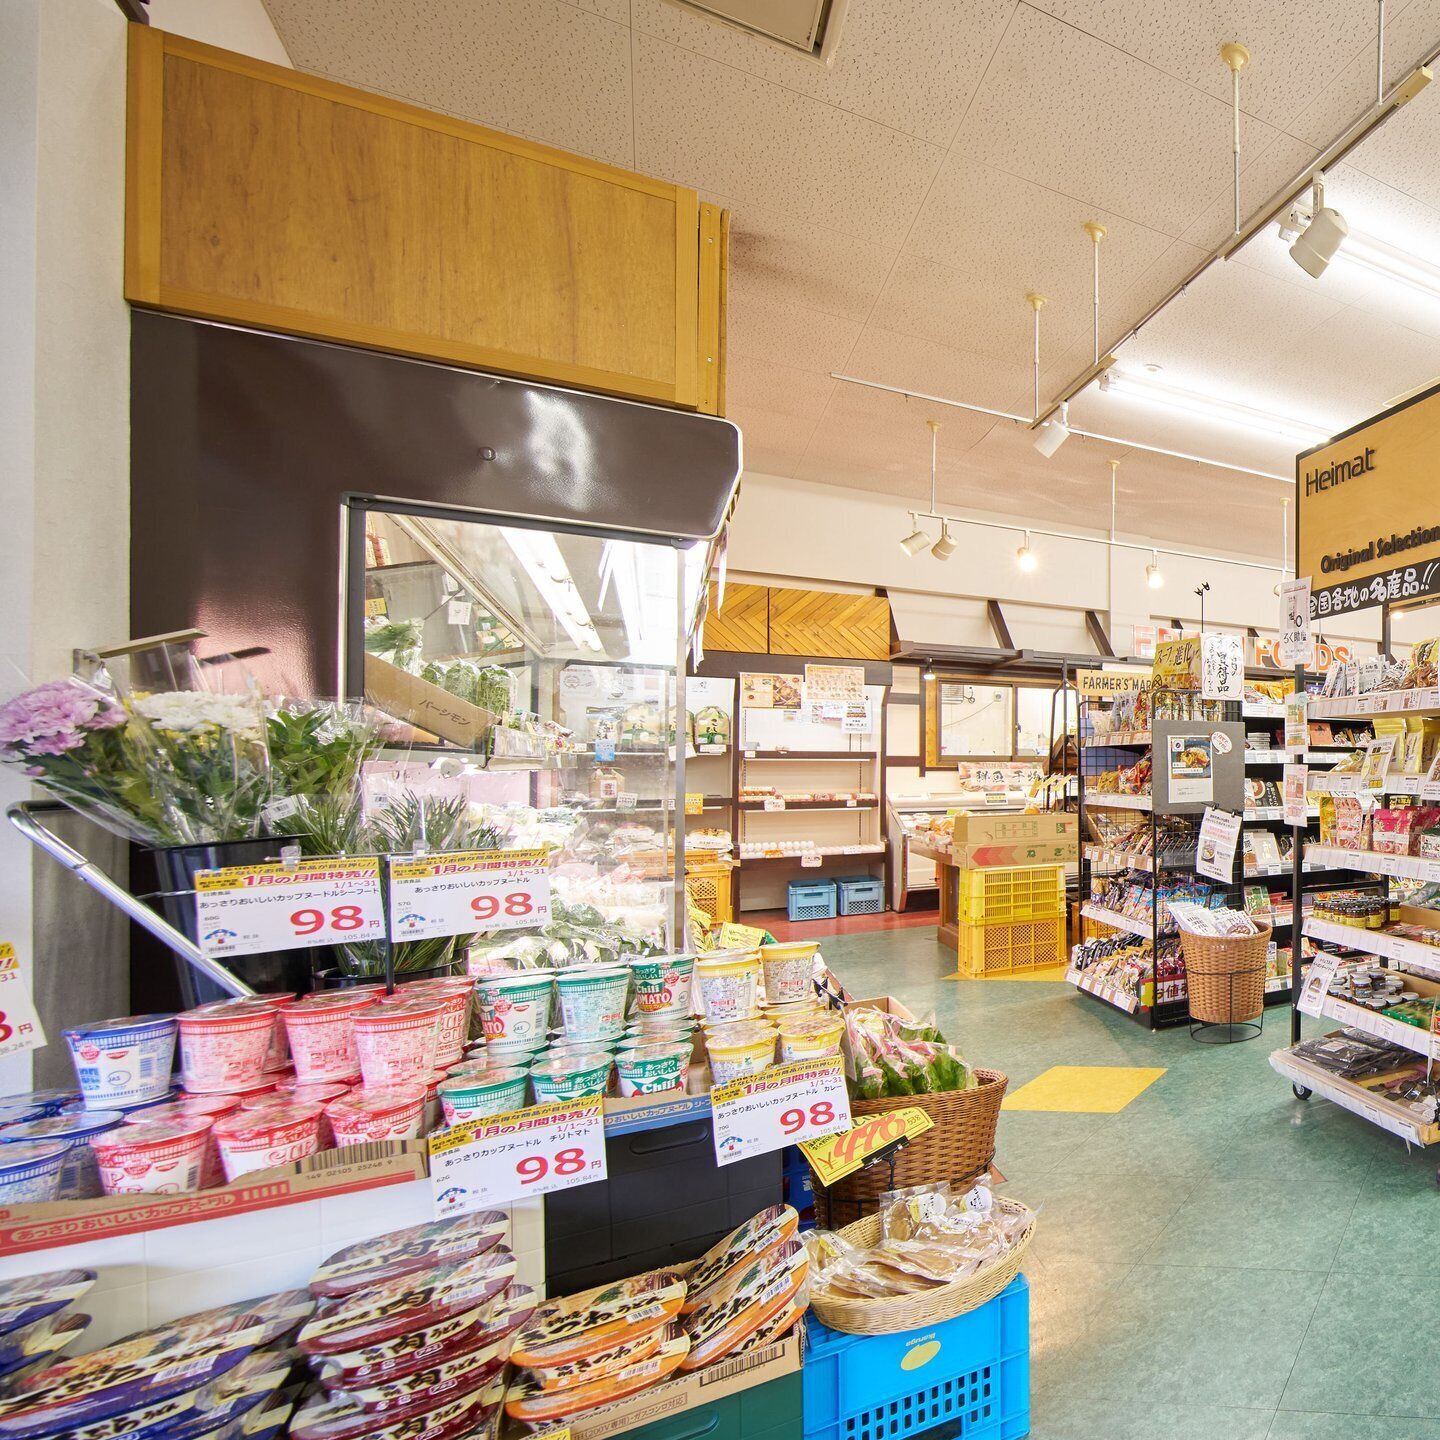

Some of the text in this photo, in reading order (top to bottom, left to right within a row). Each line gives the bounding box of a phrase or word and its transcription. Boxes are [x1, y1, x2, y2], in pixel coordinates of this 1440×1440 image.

[1305, 447, 1377, 497] Heimat
[1320, 538, 1374, 575] Original
[1255, 637, 1352, 675] FDS
[1082, 676, 1152, 692] FARMER'S MAR
[242, 869, 377, 887] 1月の月間特売!!
[430, 858, 545, 876] 1月の月間特売!!
[200, 888, 380, 910] あっさりおいしいカップヌードルシーフード
[414, 877, 530, 895] あっさりおいしいカップヌードル
[290, 905, 380, 936] 98 円
[470, 892, 547, 920] 98 円
[18, 1023, 33, 1035] 円
[641, 1079, 676, 1094] Chili
[743, 1067, 841, 1095] 1月の月間特売!!
[717, 1085, 842, 1119] あっさりおいしいカップヌードル カレー
[470, 1106, 600, 1141] 1月の月間特売!!
[780, 1101, 836, 1136] 98
[838, 1112, 848, 1121] 円
[444, 1128, 590, 1167] あっさりカップヌードル チリトマト
[516, 1147, 602, 1185] 98 円
